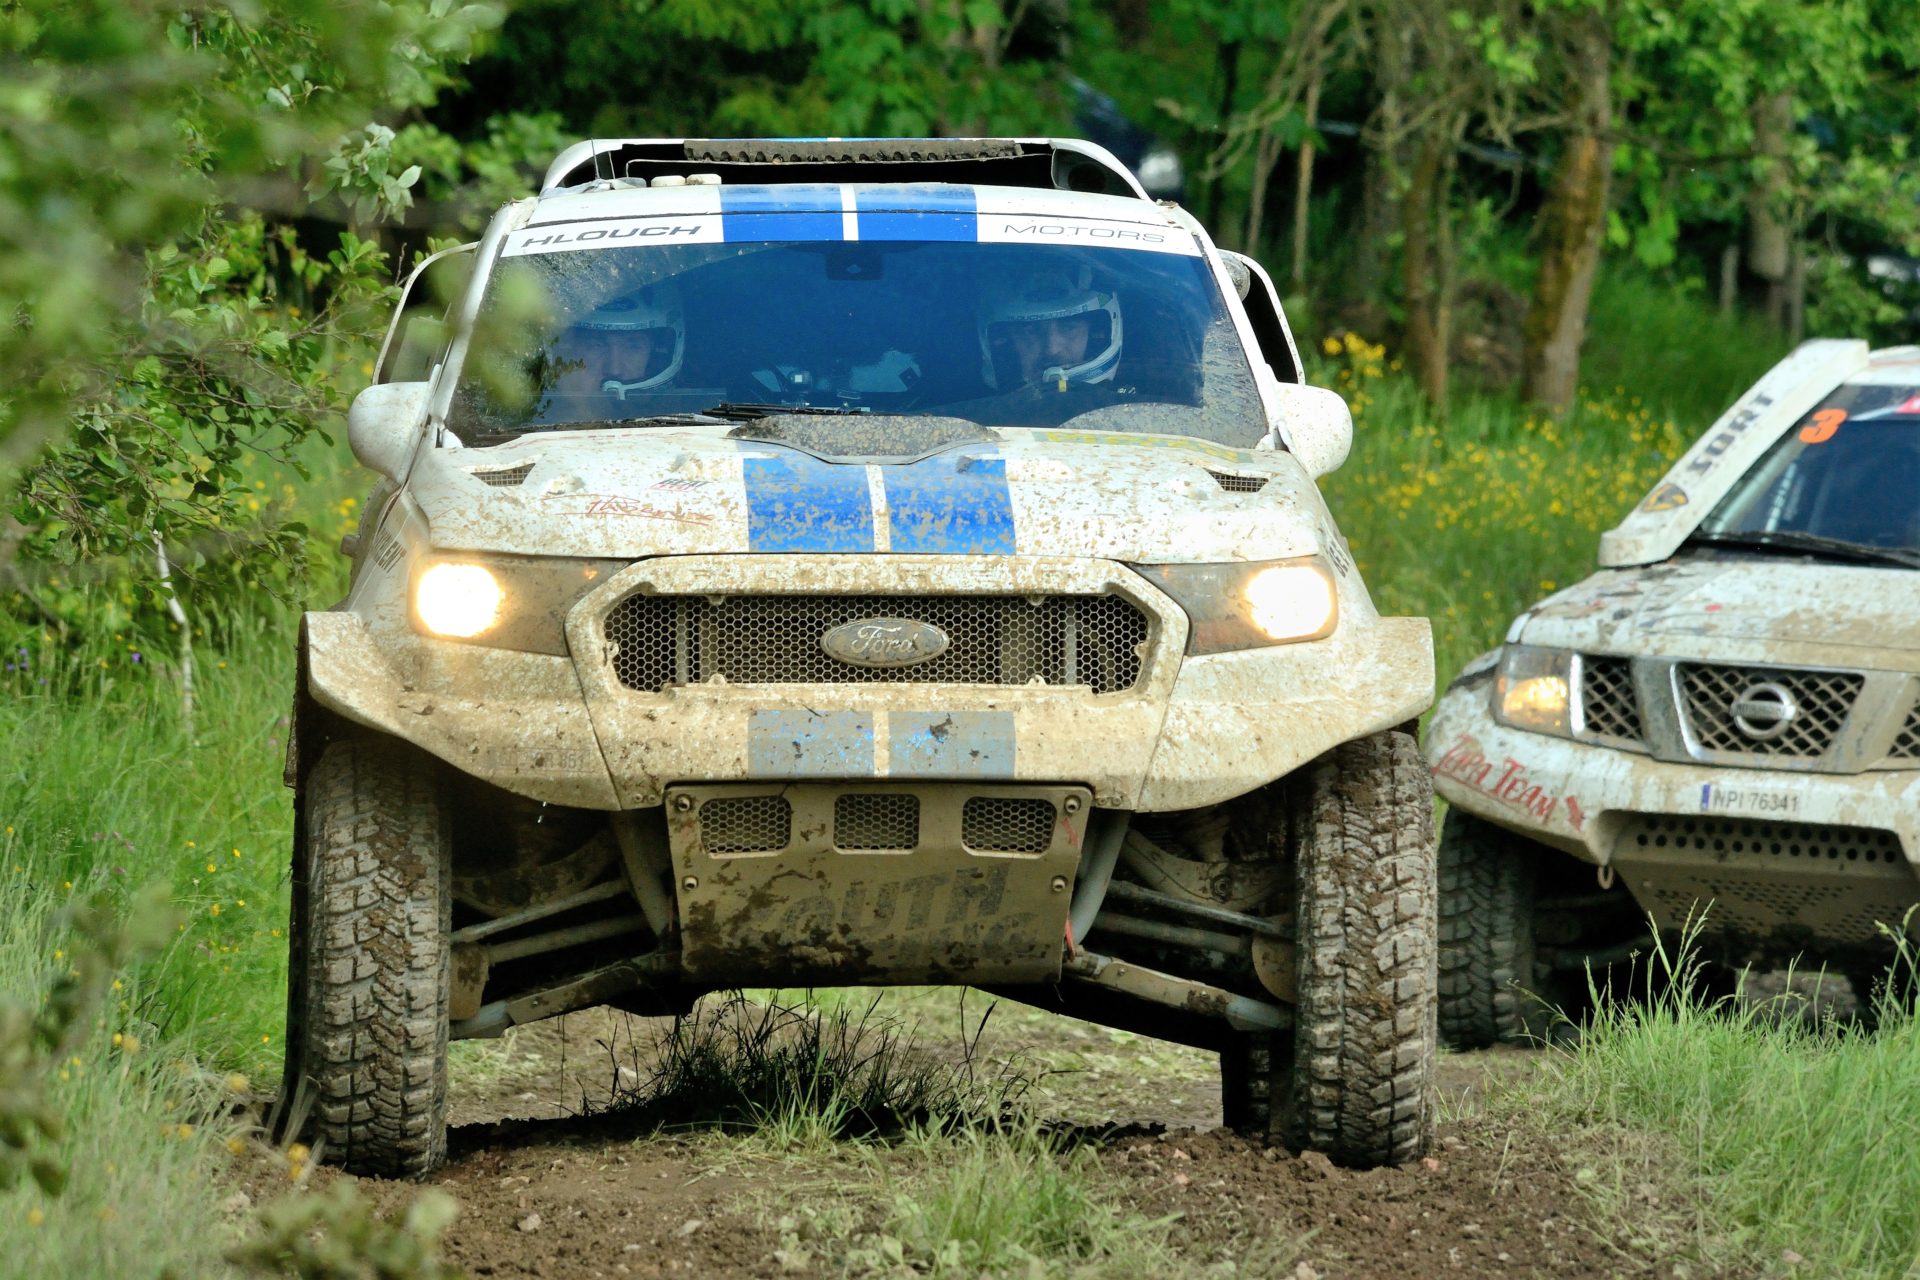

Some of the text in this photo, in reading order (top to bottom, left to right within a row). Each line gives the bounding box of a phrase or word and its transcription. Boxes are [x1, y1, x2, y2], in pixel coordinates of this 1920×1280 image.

[521, 226, 701, 248] HLOUCH
[1004, 224, 1165, 243] MOTORS
[1798, 408, 1848, 444] 3
[850, 625, 919, 654] Ford
[1749, 791, 1799, 813] 76341
